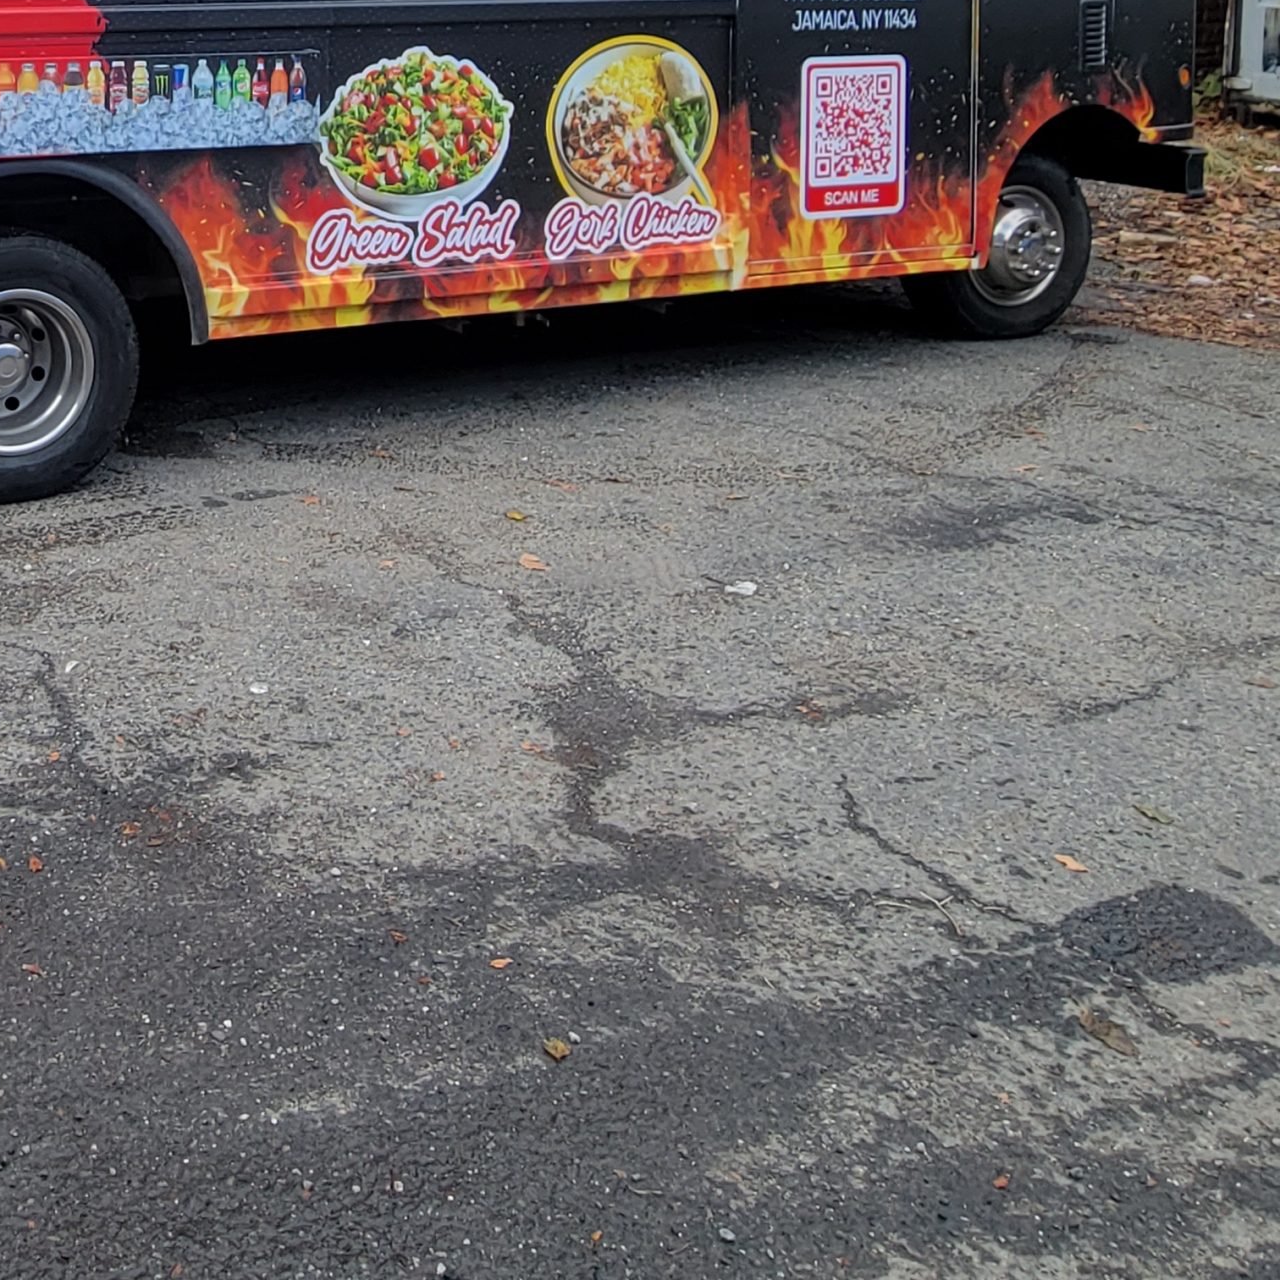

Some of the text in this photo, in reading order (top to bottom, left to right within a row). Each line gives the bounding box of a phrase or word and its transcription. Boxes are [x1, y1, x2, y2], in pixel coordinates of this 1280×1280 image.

[792, 9, 917, 31] JAMAICA, NY 11434
[824, 189, 880, 206] SCAN ME
[313, 200, 514, 266] Green Salad
[548, 197, 717, 252] Jerk Chicken
